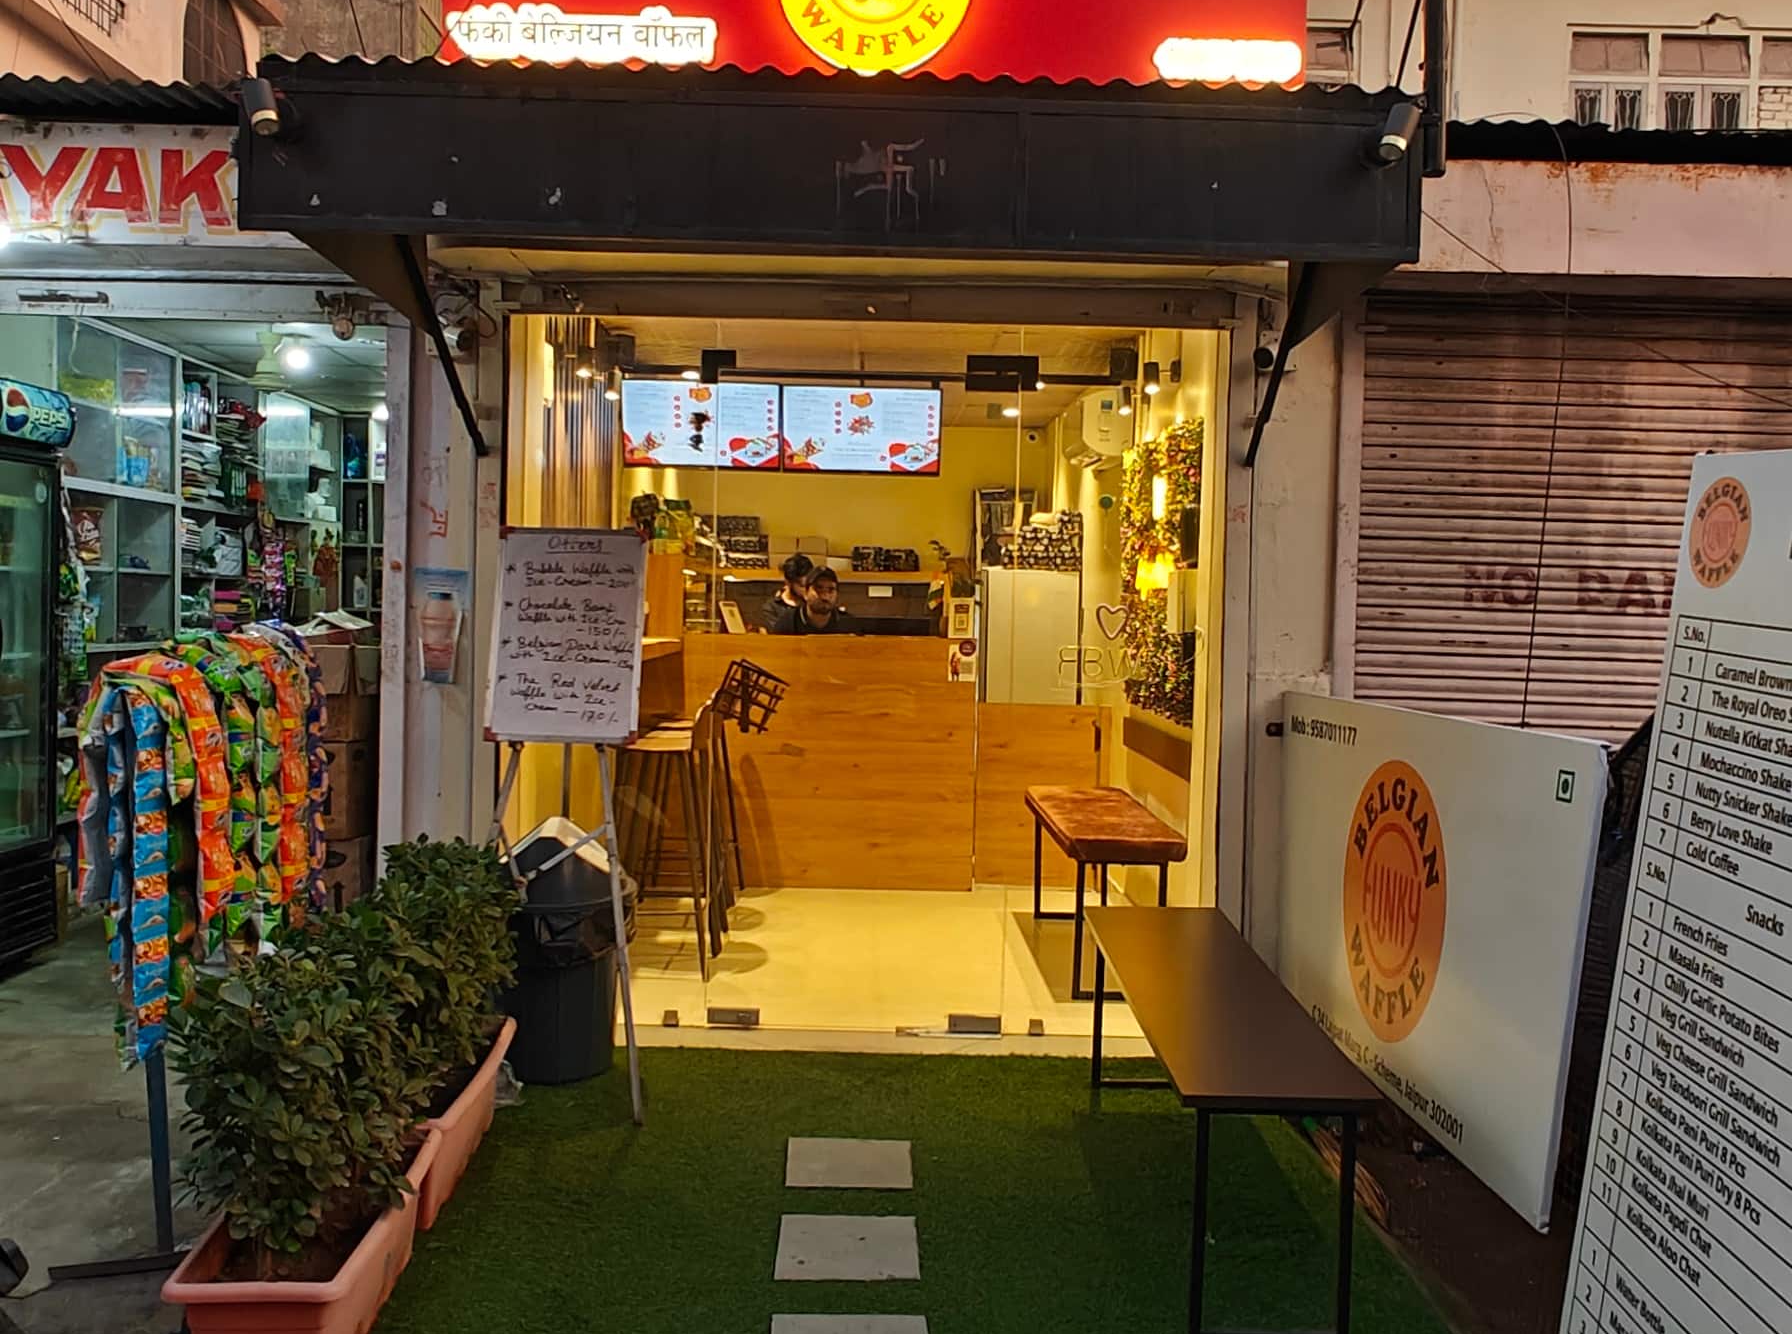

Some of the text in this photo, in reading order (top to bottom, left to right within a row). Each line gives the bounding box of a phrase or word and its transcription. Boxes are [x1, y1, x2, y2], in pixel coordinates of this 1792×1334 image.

[0, 144, 233, 227] YAK
[1464, 566, 1537, 605] NO
[1683, 626, 1705, 644] S.No.
[1688, 657, 1693, 673] 1
[1715, 663, 1757, 685] Caramel
[1677, 713, 1684, 730] 3
[1704, 720, 1739, 744] Nutella
[1742, 730, 1773, 752] Kitkat
[1681, 685, 1689, 703] 2
[1712, 690, 1729, 709] The
[1731, 695, 1760, 718] Royal
[1760, 701, 1786, 722] Oreo
[1672, 742, 1792, 793] 4 Mochaccino Shake
[1663, 802, 1773, 855] 6 Berry Love Shake
[1667, 773, 1792, 828] 5 Nutty Snicker Shake
[1353, 777, 1440, 890] BELGIAN
[1659, 828, 1740, 876] 7 Cold Coffee
[1362, 861, 1422, 948] FUNKY
[1645, 862, 1784, 937] S.No. Snacks
[1649, 902, 1728, 957] 1 French Fries
[1351, 922, 1426, 1025] WAFFLE
[1642, 930, 1724, 989] 2 Masala Fries
[1633, 987, 1745, 1068] 4 Veg Grill Sandwich
[1638, 959, 1780, 1054] 3 Chilly Garlic Potato Bites
[1629, 1015, 1779, 1128] 5 Veg Cheese Grill Sandwich
[1429, 1099, 1464, 1145] 302001
[1621, 1071, 1747, 1179] 7 Kolkata Pani Puri 8 Pcs
[1624, 1044, 1781, 1168] 6 Veg Tandoori Grill Sandwich
[1612, 1128, 1619, 1145] 9
[1636, 1147, 1667, 1185] Kolkata
[1616, 1100, 1761, 1226] 8 Kolkata Pani Puri Dry 8 Pcs
[1602, 1182, 1701, 1288] 11 Kolkata Aloo Chat
[1606, 1154, 1713, 1259] 10 Kolkata Papdi Chat
[1585, 1284, 1592, 1303] 2
[1592, 1249, 1597, 1267] 1
[1615, 1272, 1640, 1309] Water
